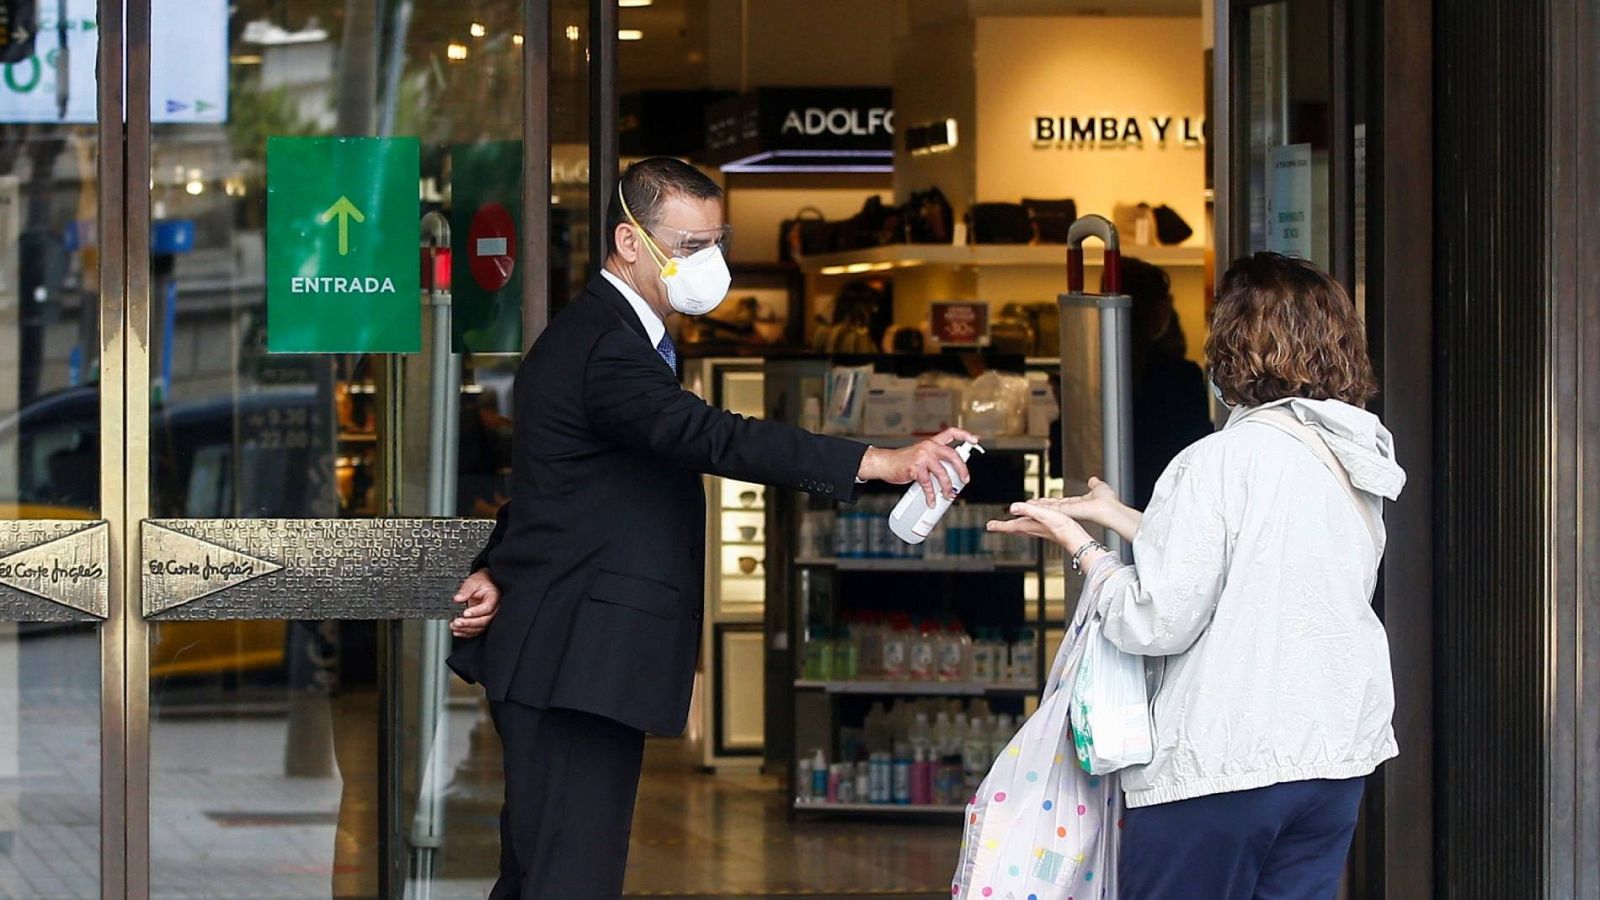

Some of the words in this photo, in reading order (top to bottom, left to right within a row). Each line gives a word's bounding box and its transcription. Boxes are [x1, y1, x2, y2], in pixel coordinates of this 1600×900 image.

[1035, 117, 1142, 141] BIMBA
[1152, 117, 1171, 141] Y
[1184, 117, 1206, 141] L
[291, 276, 396, 294] ENTRADA
[369, 518, 424, 529] INGLES
[14, 560, 49, 578] Corte
[164, 559, 200, 576] Corte
